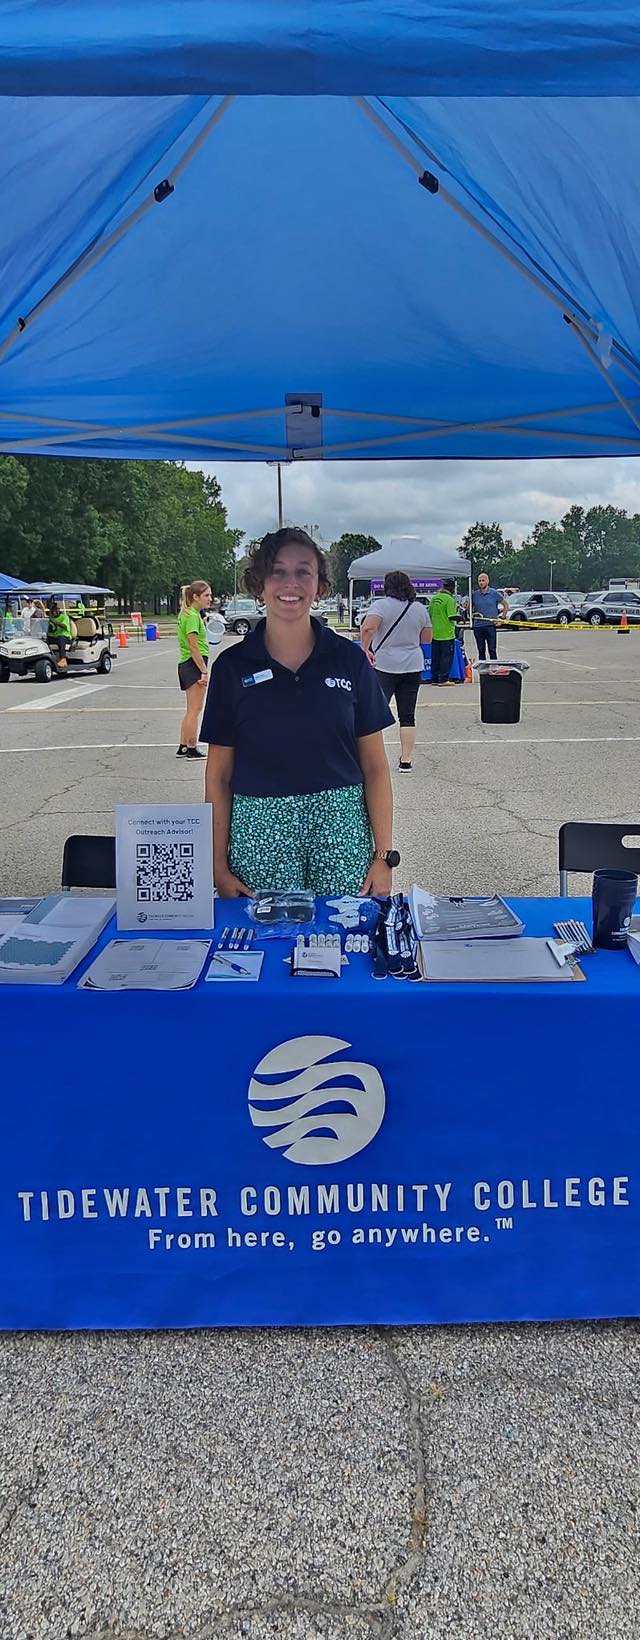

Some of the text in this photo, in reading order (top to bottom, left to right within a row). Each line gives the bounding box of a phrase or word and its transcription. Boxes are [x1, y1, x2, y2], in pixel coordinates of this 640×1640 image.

[334, 678, 352, 692] TCC
[18, 1176, 630, 1222] TIDEWATER COMMUNITY COLLEGE
[148, 1228, 216, 1250] From
[227, 1227, 296, 1251] here,
[311, 1229, 341, 1250] go
[352, 1223, 490, 1248] anywhere.
